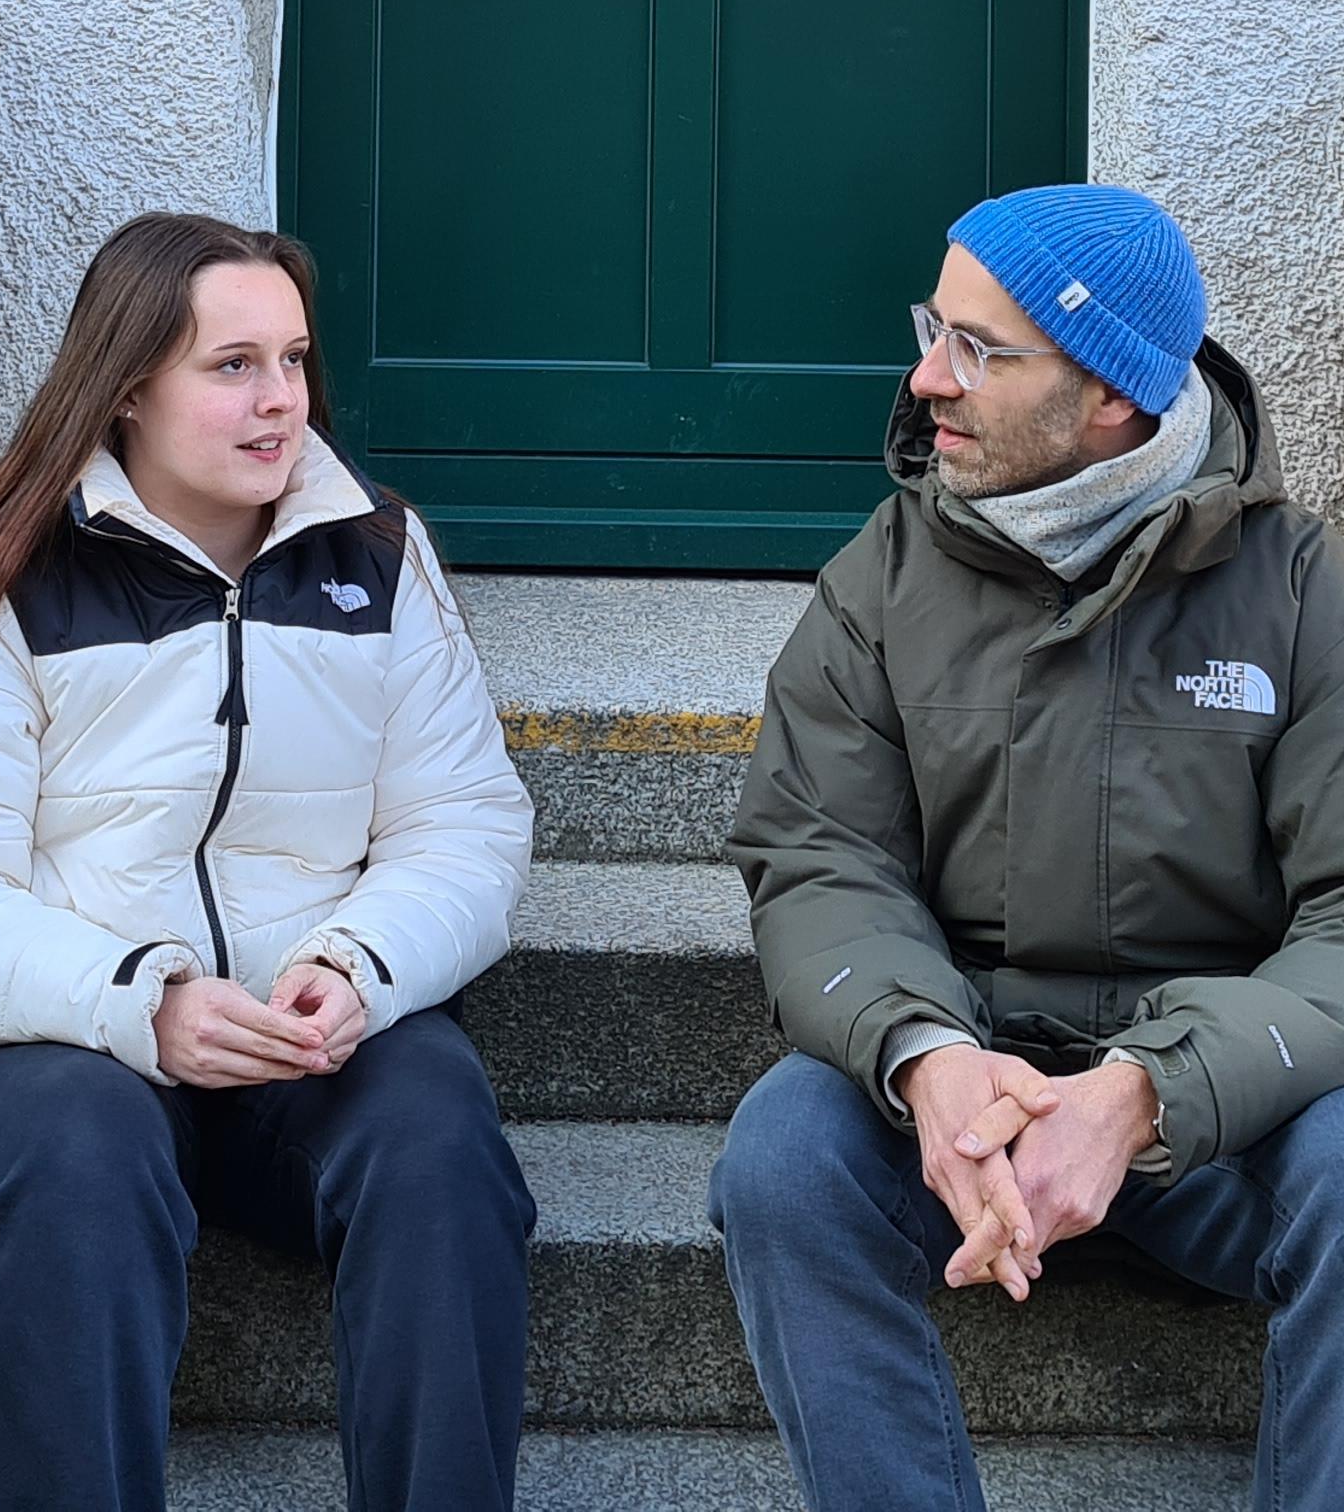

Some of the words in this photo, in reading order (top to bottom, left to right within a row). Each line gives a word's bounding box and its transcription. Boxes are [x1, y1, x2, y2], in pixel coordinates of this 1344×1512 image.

[1205, 660, 1245, 678] THE
[1175, 675, 1243, 694] NORTH
[1194, 691, 1244, 710] FACE
